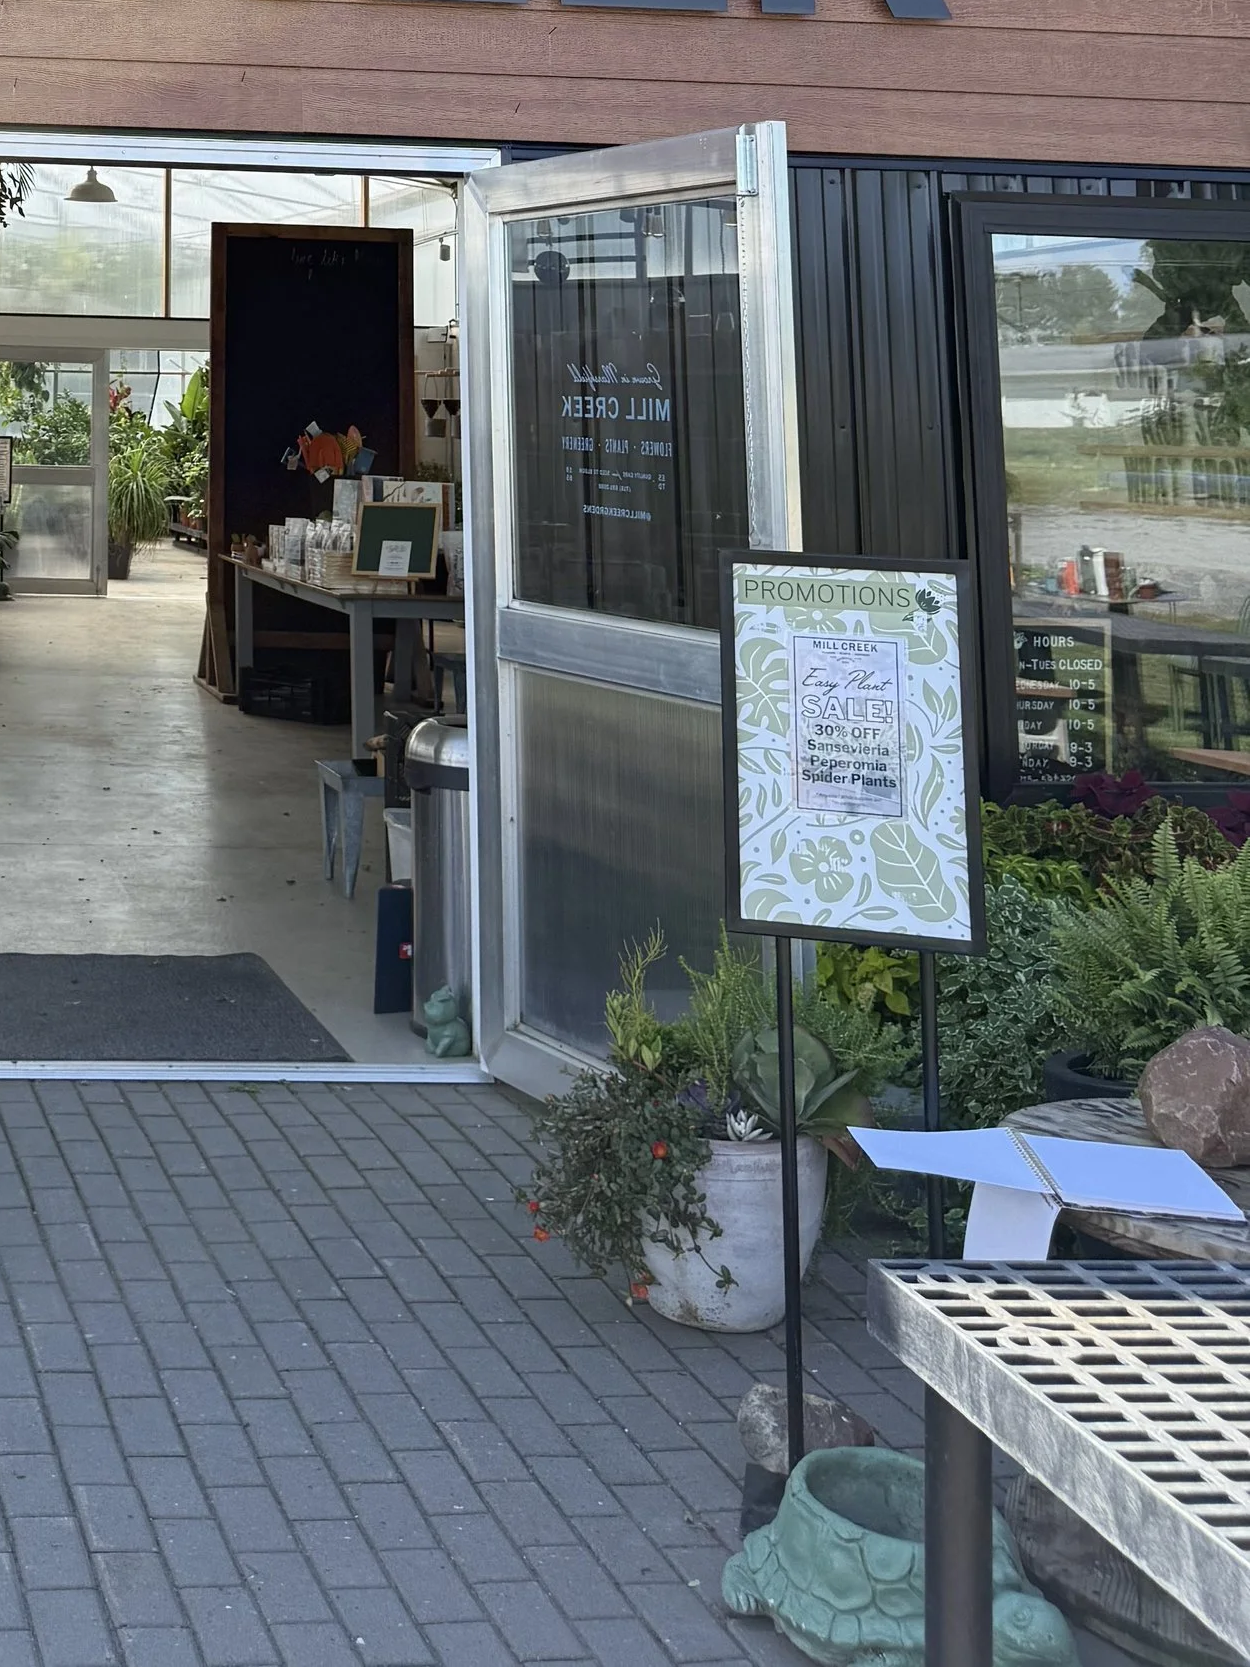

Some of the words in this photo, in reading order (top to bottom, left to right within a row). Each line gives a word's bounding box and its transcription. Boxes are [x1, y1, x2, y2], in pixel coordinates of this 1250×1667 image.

[744, 579, 911, 608] PROMOTIONS
[813, 640, 839, 650] MILL
[841, 642, 878, 653] CREEK
[1033, 636, 1075, 647] HOURS
[1058, 659, 1103, 670] CLOSED
[801, 667, 840, 696] Easy
[844, 669, 893, 692] Plant
[1016, 680, 1060, 690] EDNESDAY
[1069, 679, 1096, 690] 10-5
[801, 694, 894, 724] SALE!
[1017, 701, 1055, 710] URSDAY
[1068, 699, 1096, 710] 10-5
[1068, 719, 1095, 730] 10-5
[814, 724, 848, 738] 30%
[851, 726, 881, 740] OFF
[807, 739, 890, 757] Sansevieria
[810, 755, 887, 772] Peperomia
[1022, 758, 1049, 768] NDAY
[801, 770, 848, 784] Spider
[851, 773, 897, 789] Plants
